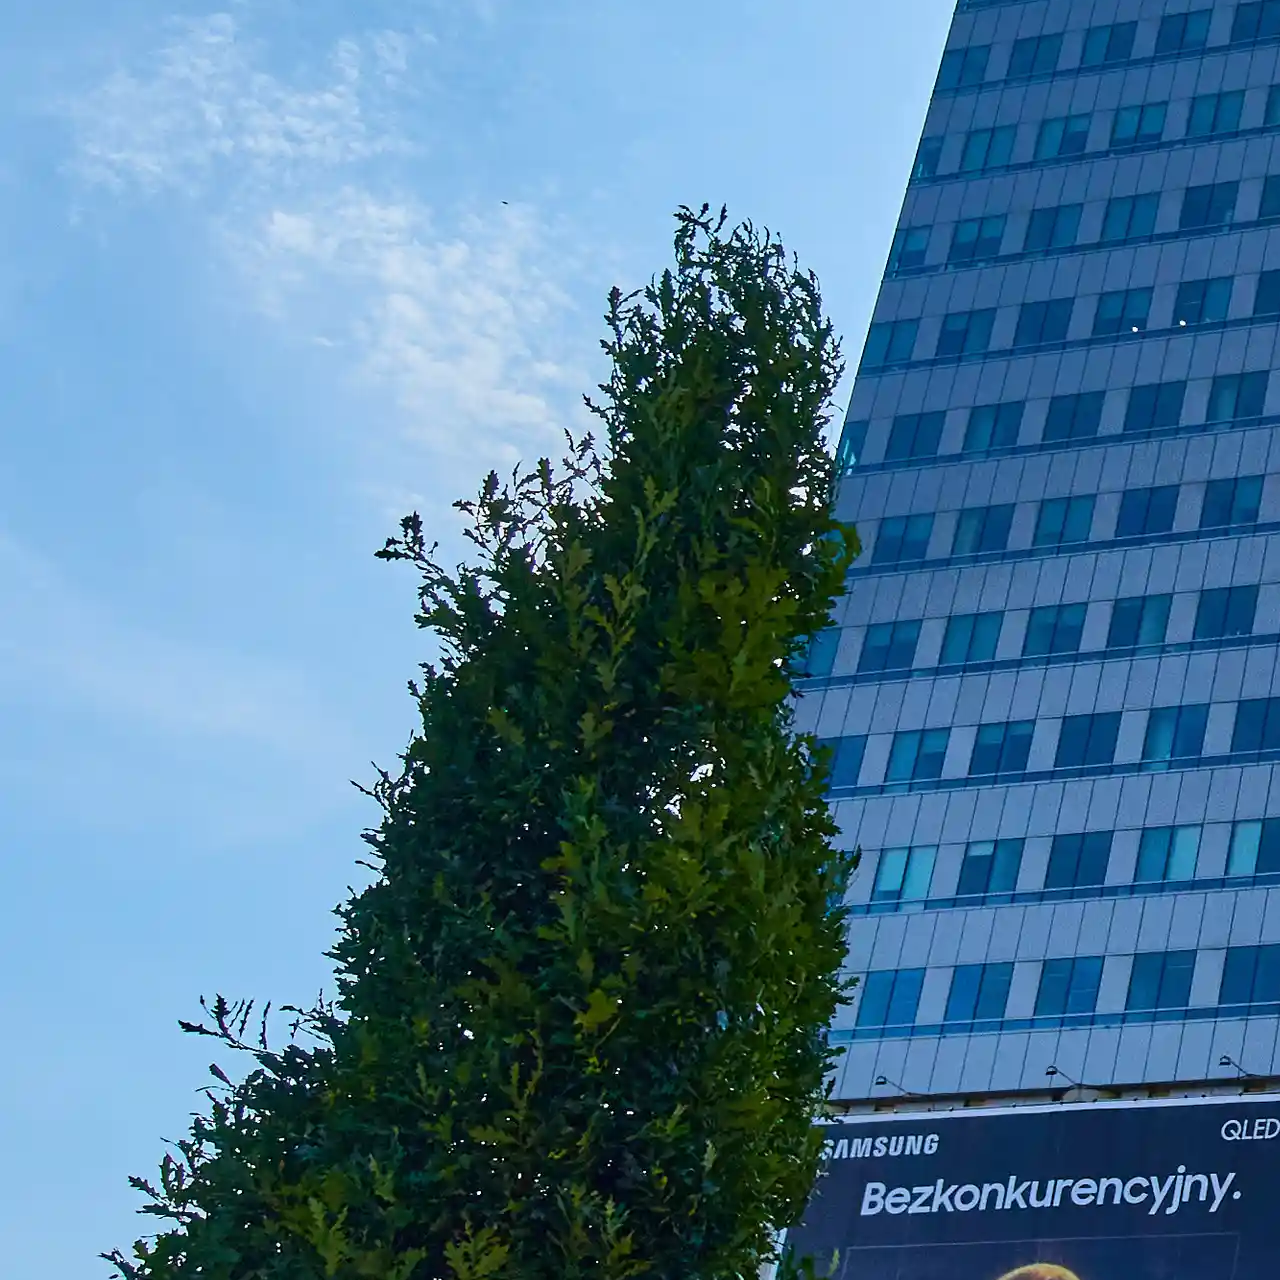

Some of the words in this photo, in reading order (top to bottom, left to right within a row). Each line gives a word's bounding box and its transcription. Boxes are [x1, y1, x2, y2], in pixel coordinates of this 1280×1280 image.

[1220, 1118, 1280, 1141] QLED
[820, 1133, 940, 1161] SAMSUNG
[860, 1164, 1242, 1216] Bezkonkurencyjny.
